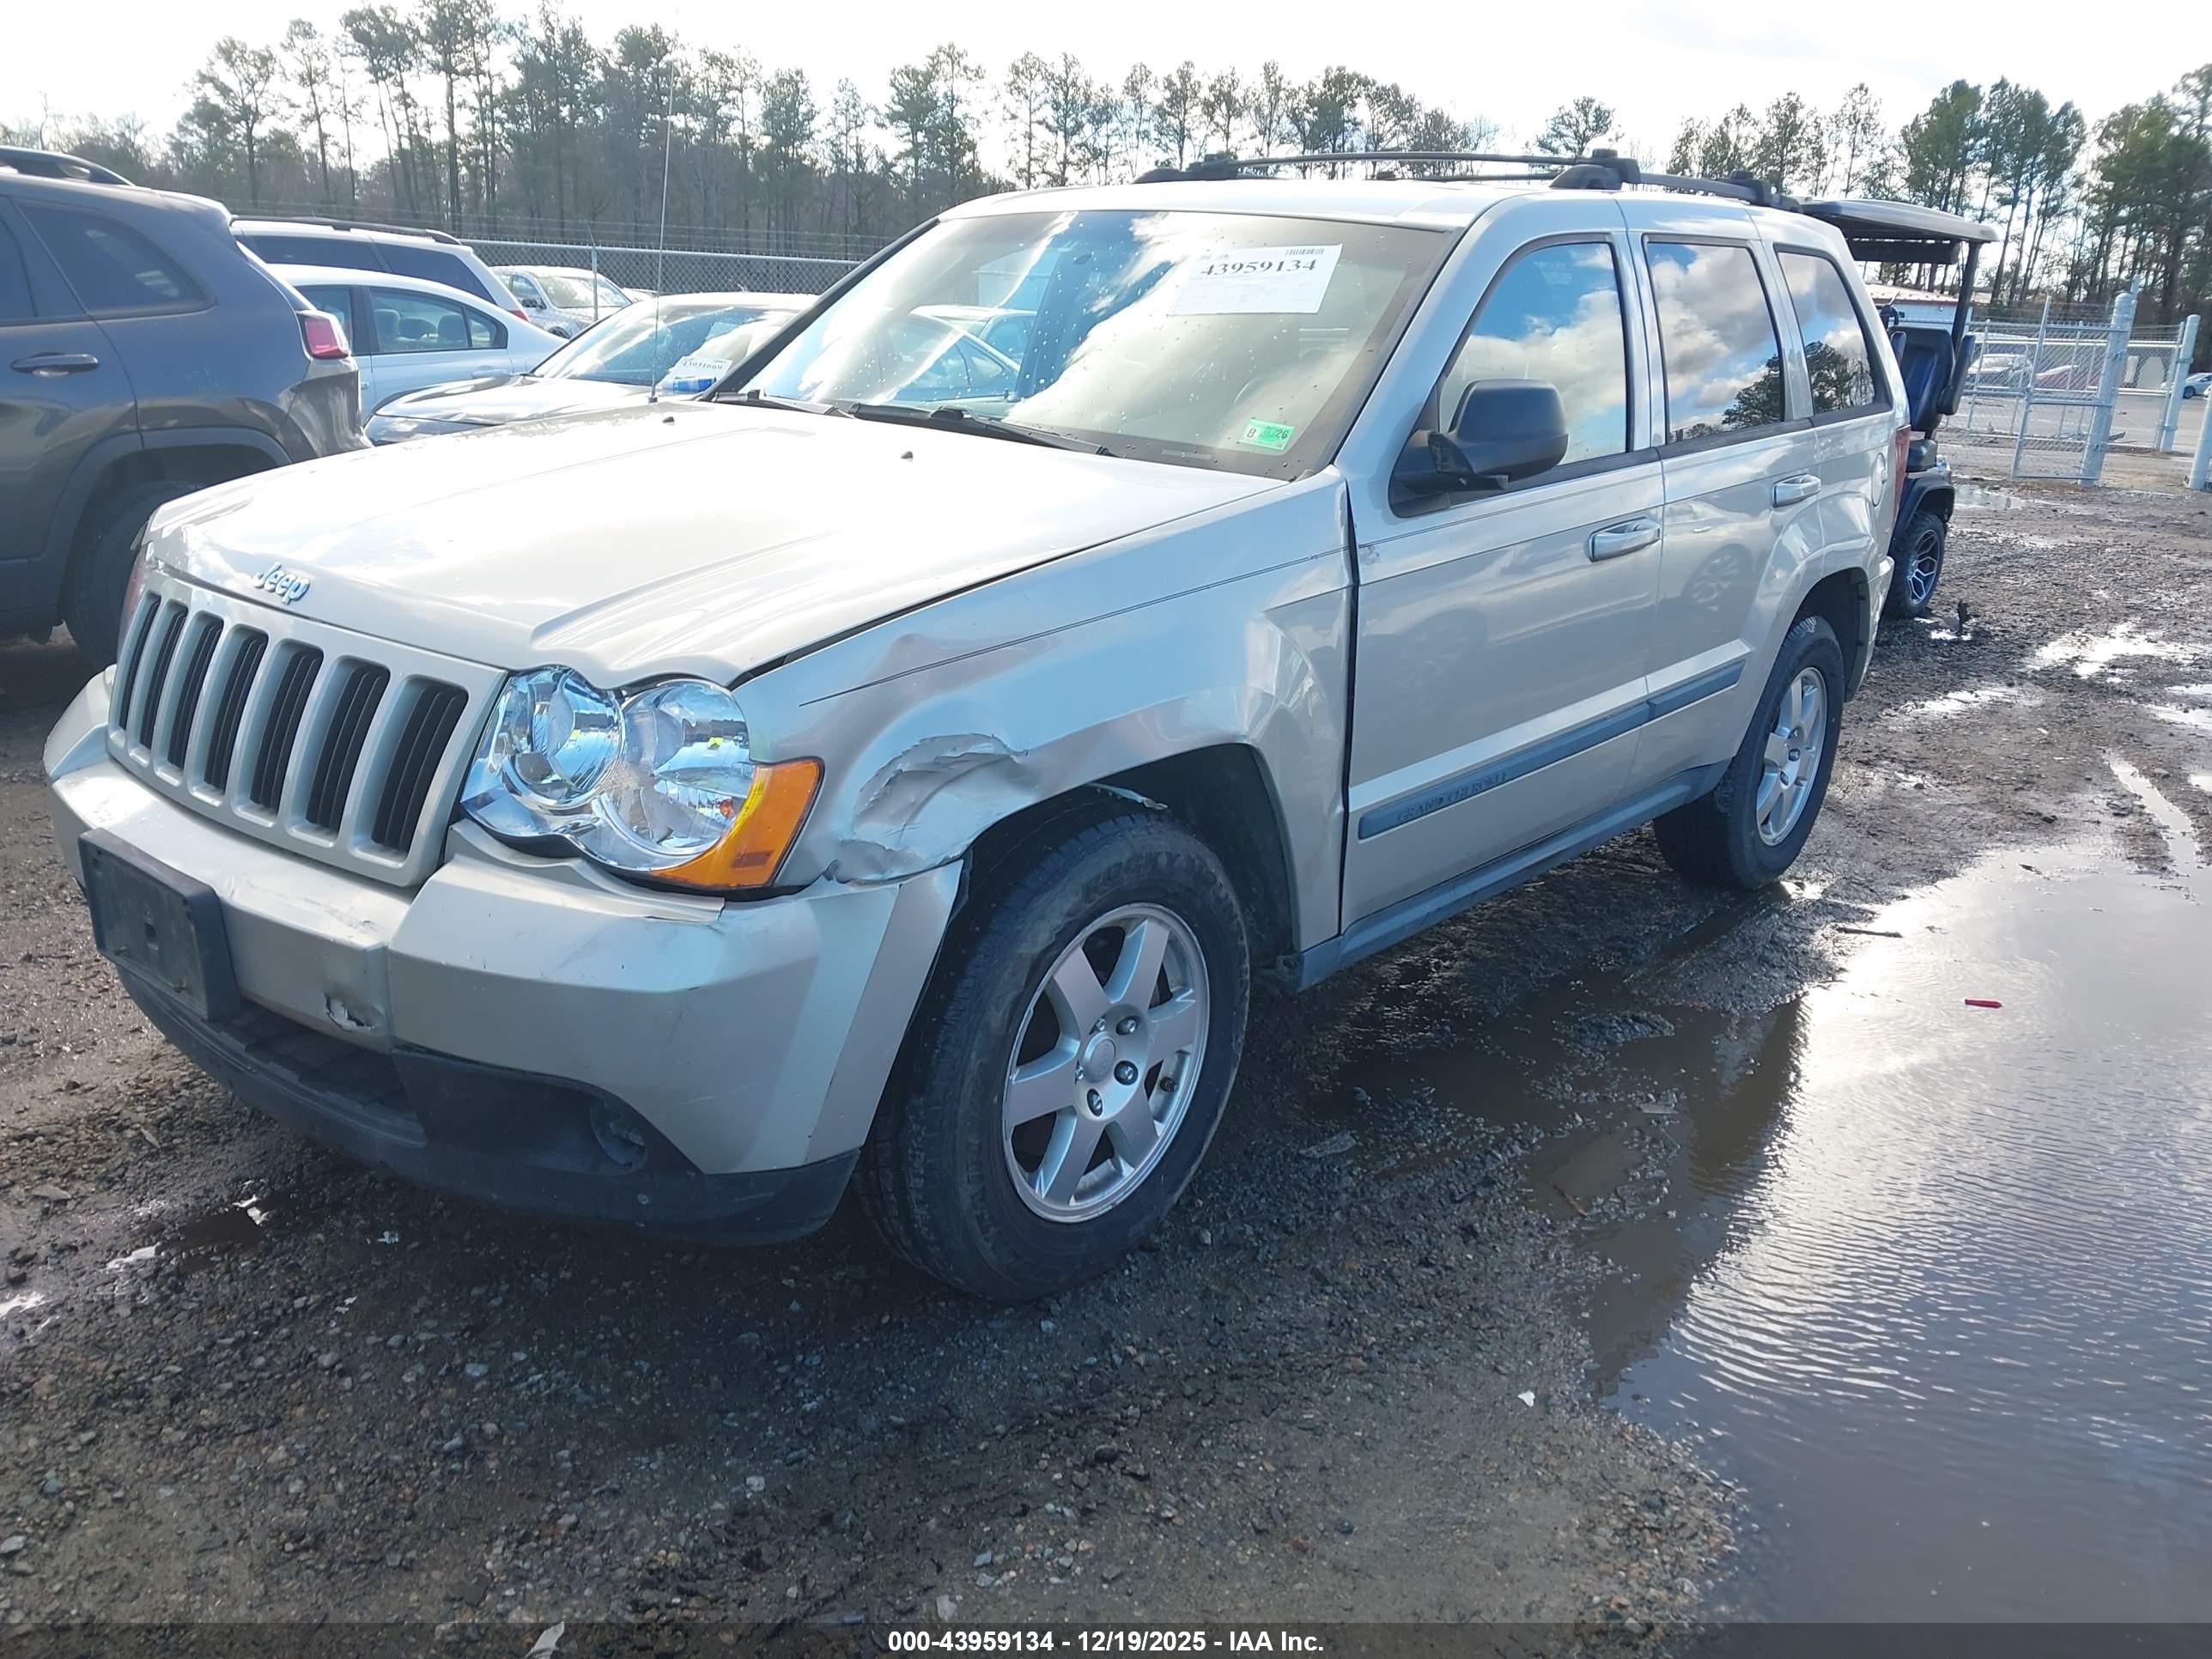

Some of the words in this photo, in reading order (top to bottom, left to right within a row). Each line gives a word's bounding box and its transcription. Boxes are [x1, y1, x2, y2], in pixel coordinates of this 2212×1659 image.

[1200, 258, 1317, 276] 43959134
[1247, 428, 1256, 438] 8
[252, 561, 310, 605] Jeep
